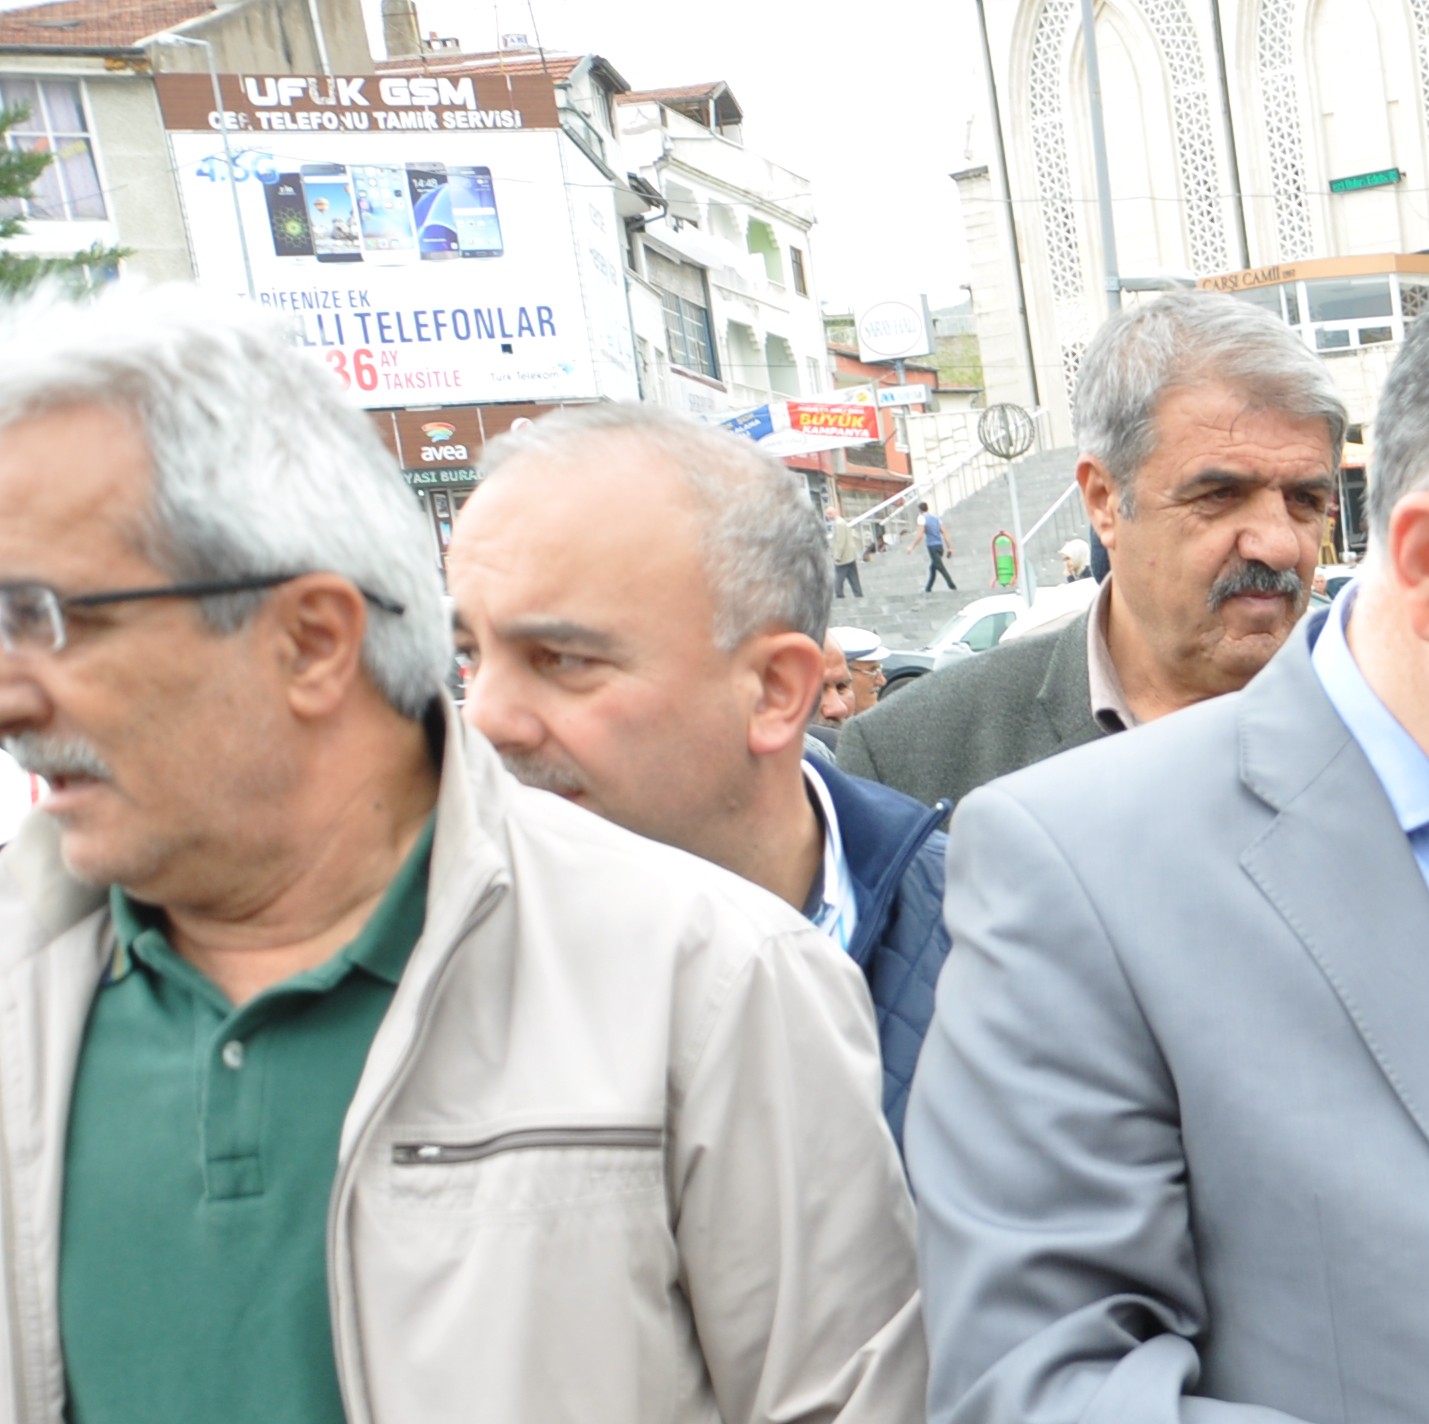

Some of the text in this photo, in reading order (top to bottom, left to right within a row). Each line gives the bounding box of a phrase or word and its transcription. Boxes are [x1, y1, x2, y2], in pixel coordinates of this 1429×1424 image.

[244, 76, 477, 110] UFUK GSM
[256, 111, 368, 131] TELEFONU
[376, 108, 438, 130] TAMİR
[441, 109, 521, 129] SERVİSİ
[348, 289, 371, 307] EK
[353, 305, 557, 346] TELEFONLAR
[326, 348, 398, 391] 36 AY
[382, 367, 463, 391] TAKSİTLE
[800, 410, 864, 428] BÜYÜK
[802, 425, 870, 439] KAMPANYA
[420, 444, 468, 462] avea
